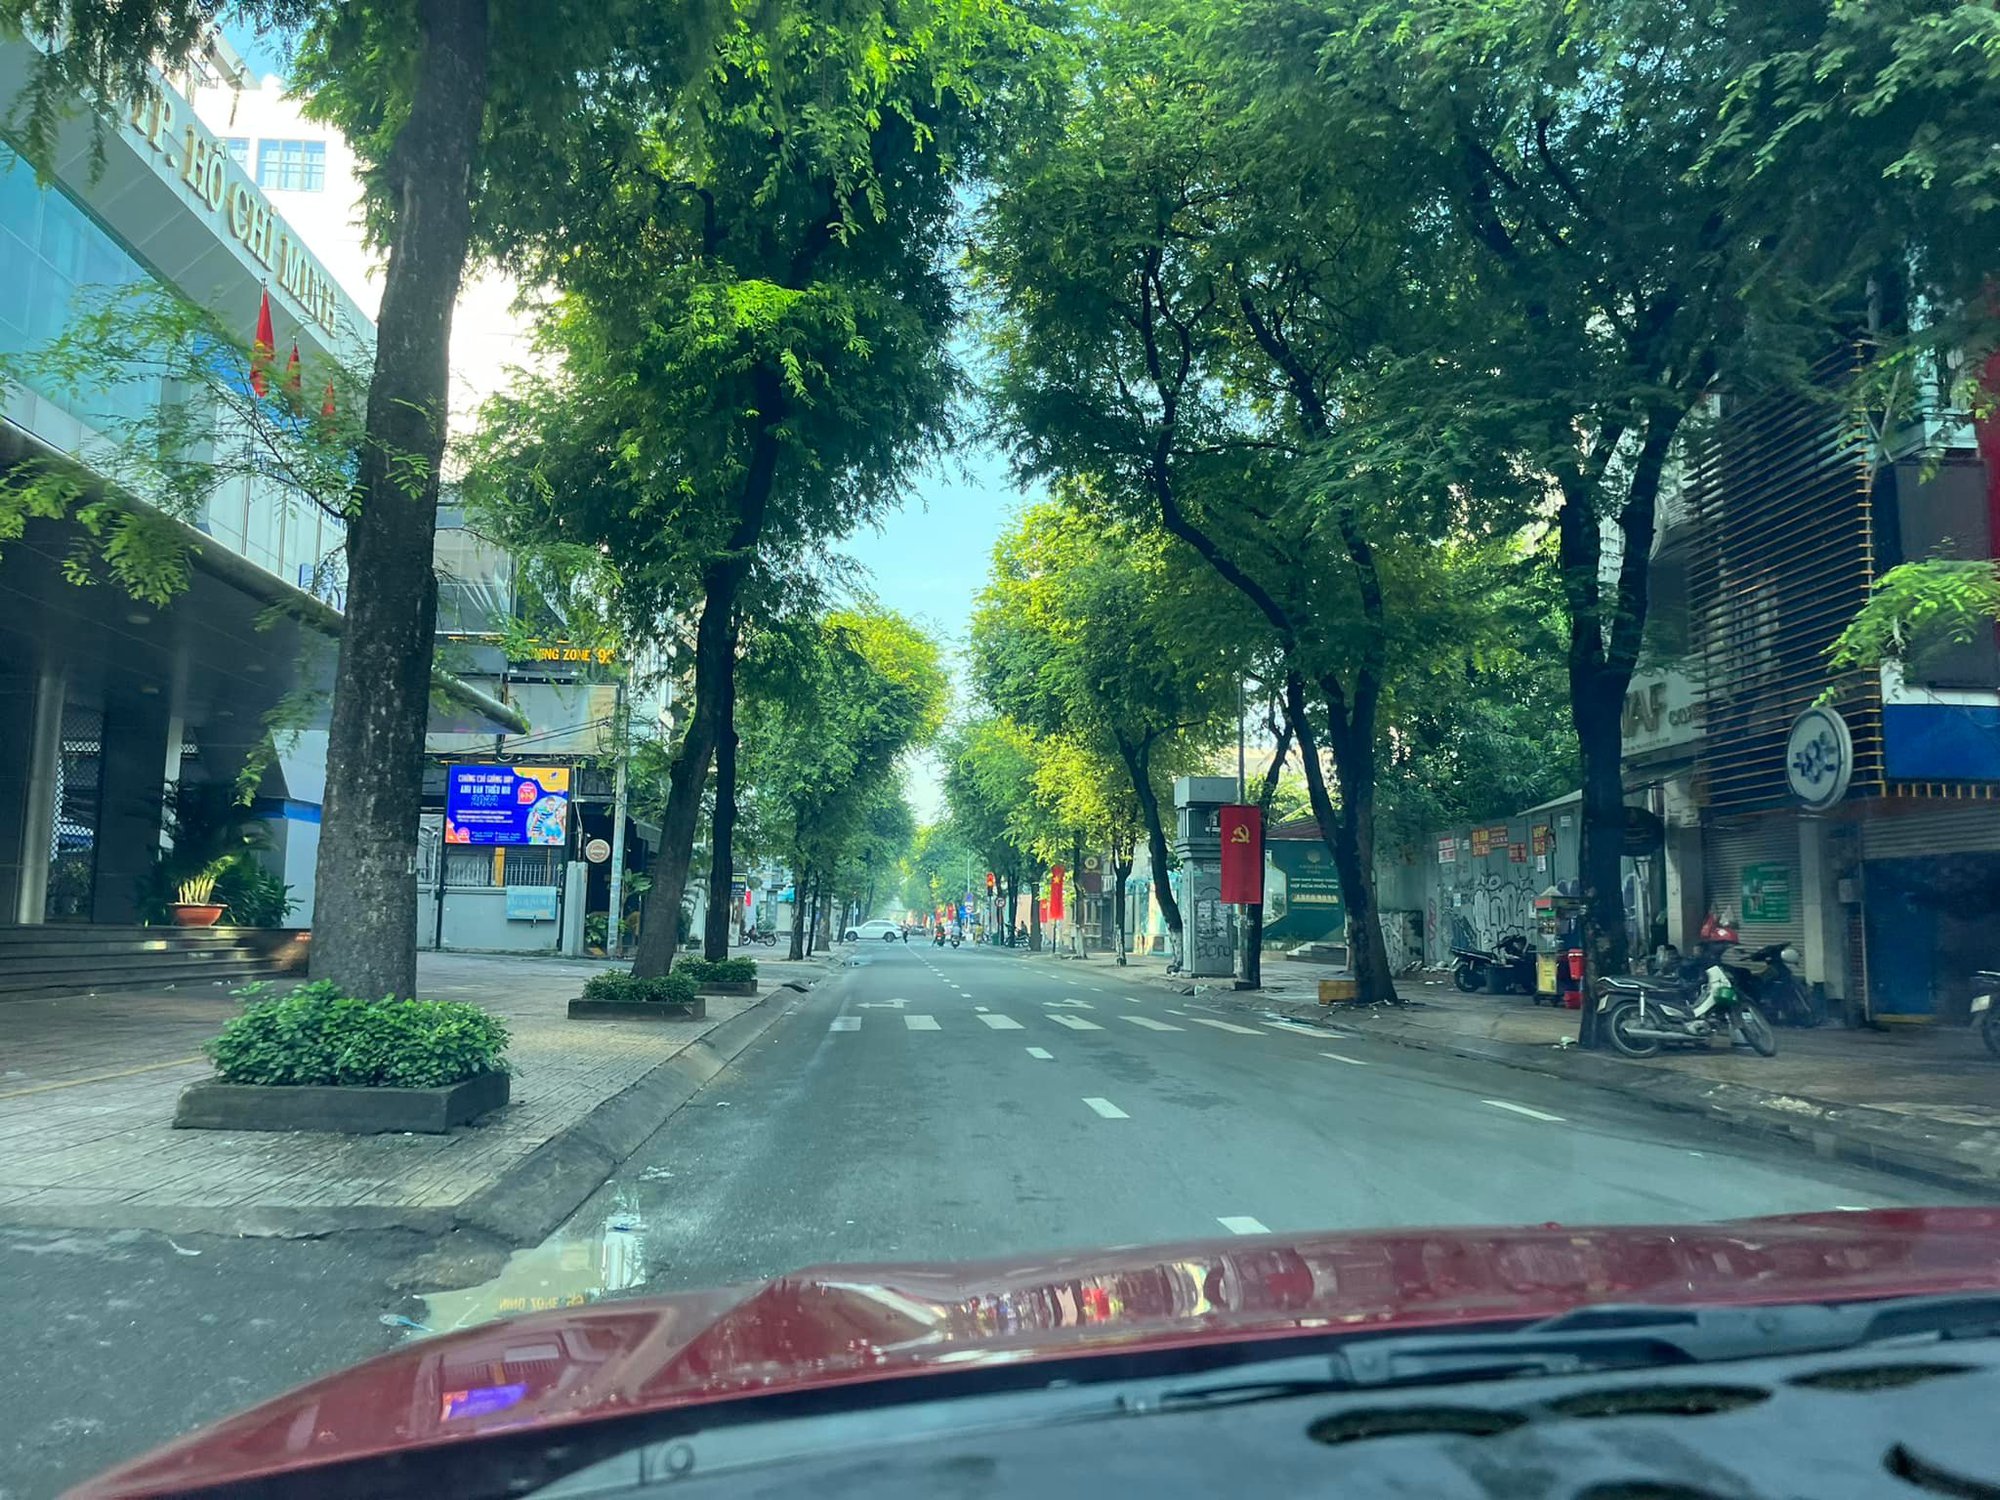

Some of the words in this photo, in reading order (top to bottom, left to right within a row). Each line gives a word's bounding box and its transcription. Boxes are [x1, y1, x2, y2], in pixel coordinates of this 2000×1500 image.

[182, 123, 227, 213] HỒ
[228, 182, 280, 273] CHÍ
[278, 232, 337, 340] MINH
[563, 648, 591, 662] ZONE
